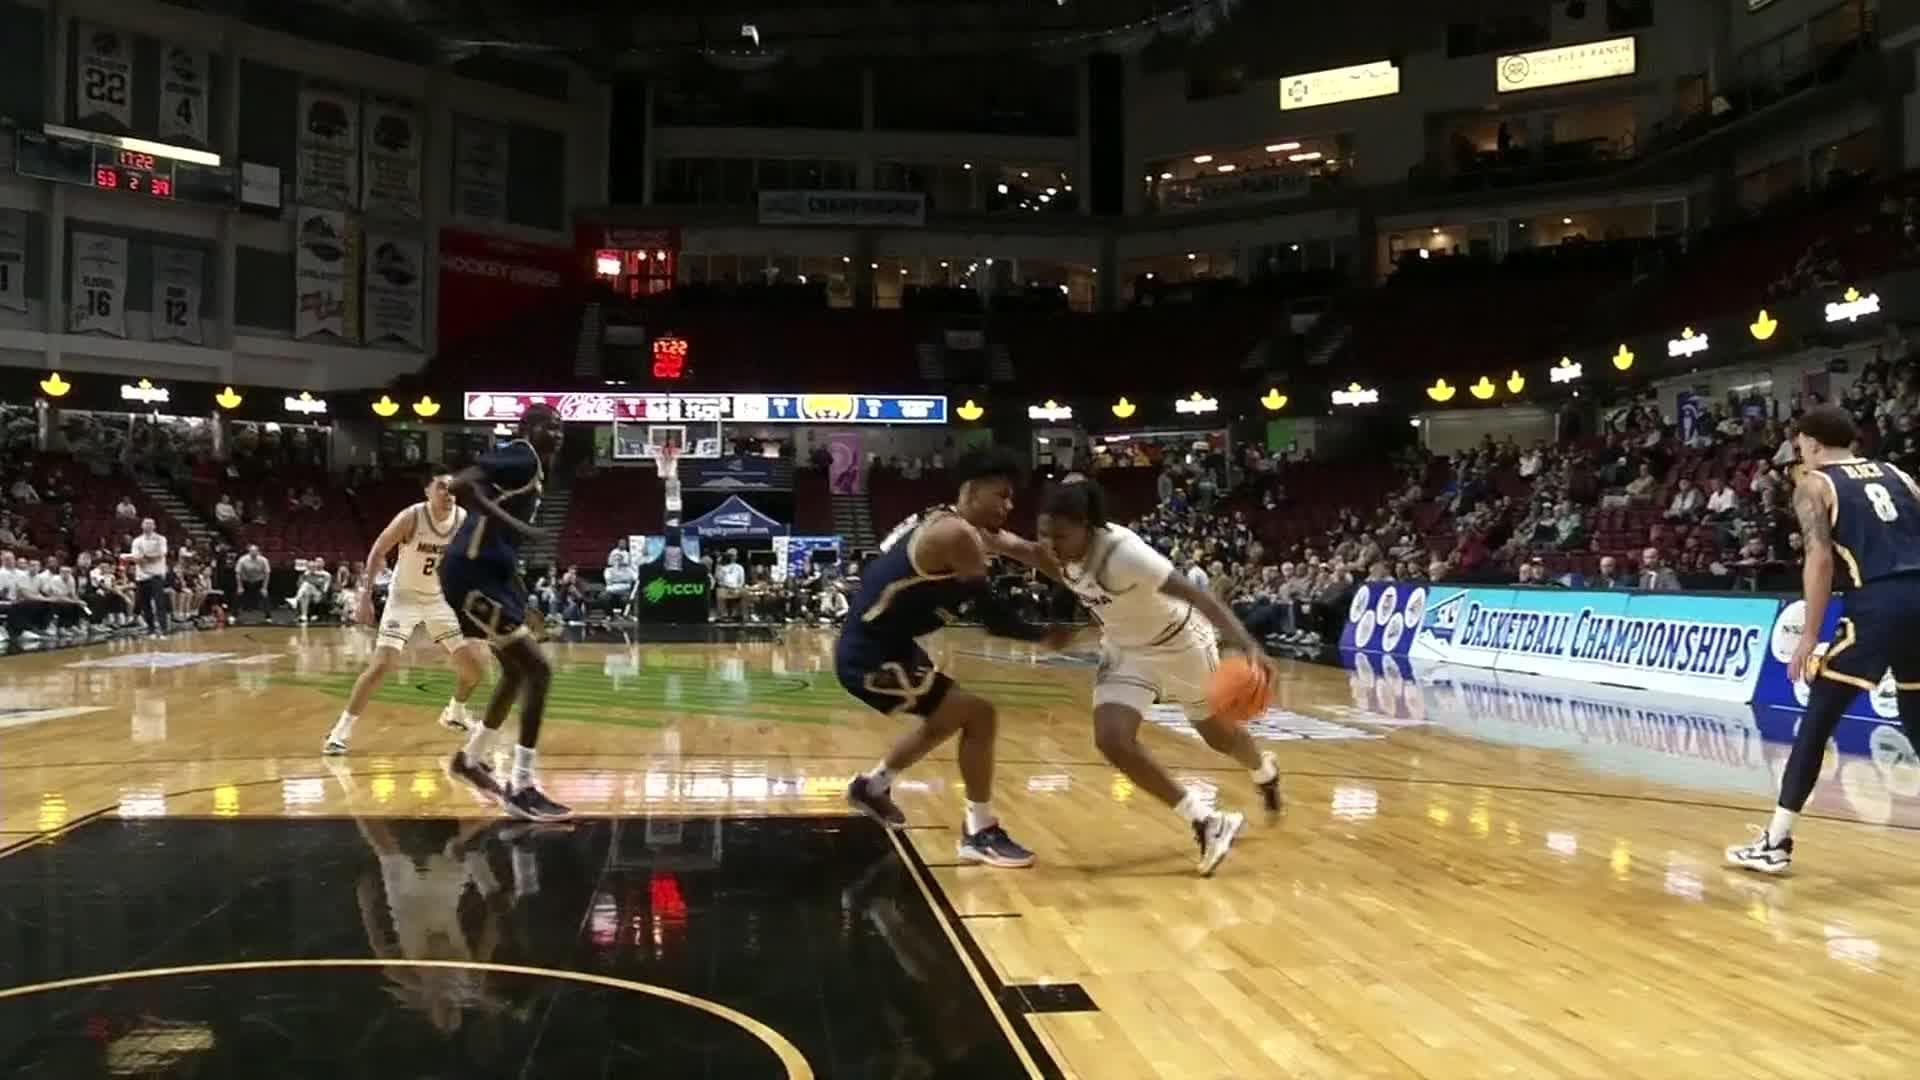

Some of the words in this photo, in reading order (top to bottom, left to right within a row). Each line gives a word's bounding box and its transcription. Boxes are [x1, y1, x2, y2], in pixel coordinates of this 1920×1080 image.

[86, 67, 126, 105] 22
[176, 97, 192, 124] 4
[129, 177, 139, 190] 2
[87, 289, 112, 317] 16
[164, 298, 187, 326] 12
[1863, 482, 1899, 522] 8
[1460, 603, 1570, 656] BASKETBALL
[1569, 609, 1759, 677] CHAMPIONSHIPS
